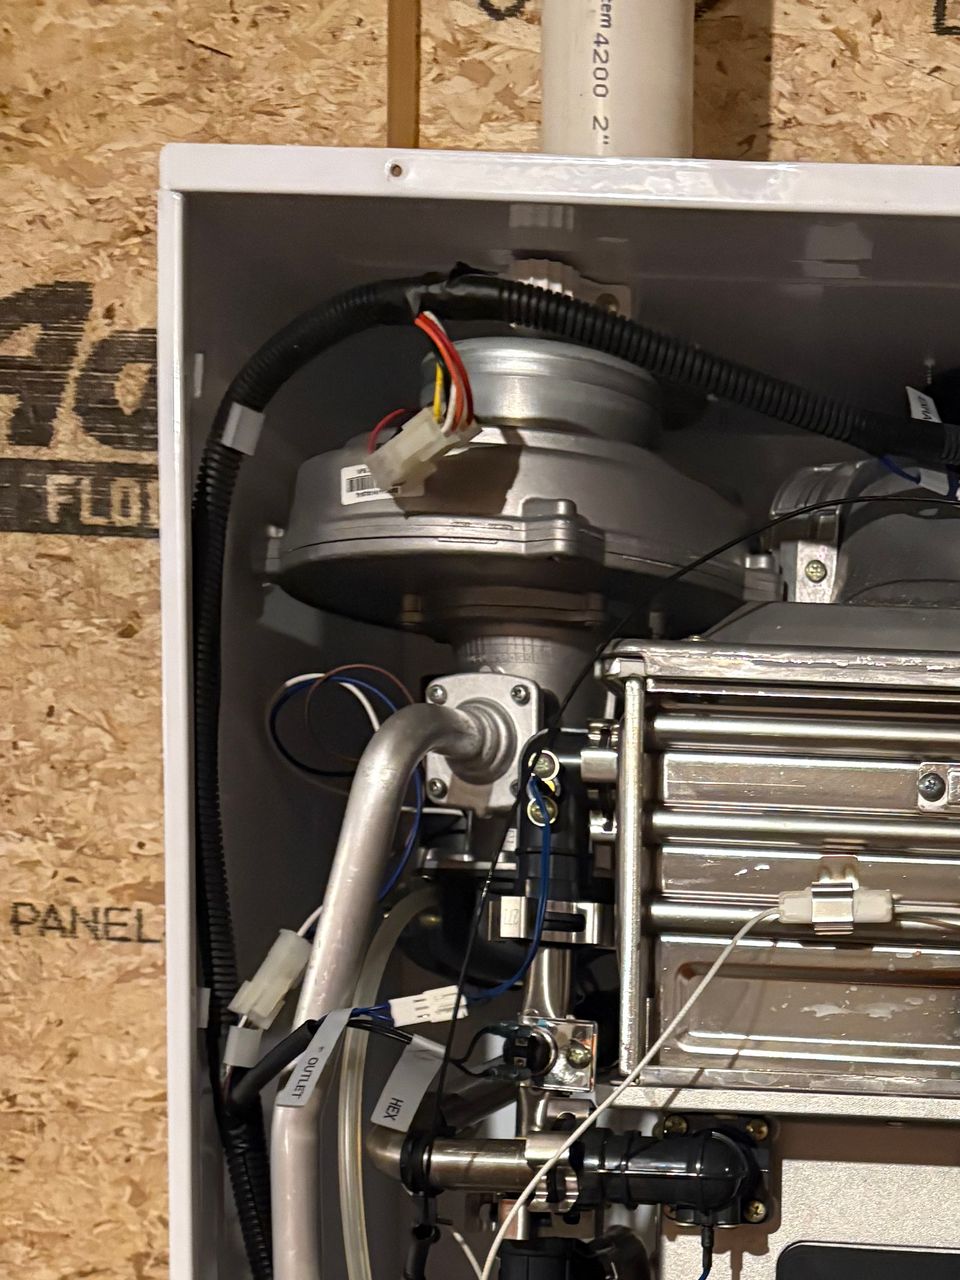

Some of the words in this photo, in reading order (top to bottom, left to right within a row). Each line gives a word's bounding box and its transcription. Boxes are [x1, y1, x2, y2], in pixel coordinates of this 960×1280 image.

[592, 32, 610, 98] 4200
[592, 115, 611, 145] 2"
[9, 902, 162, 943] PANEL
[291, 1056, 319, 1100] OUTLET
[383, 1097, 404, 1121] HEX
